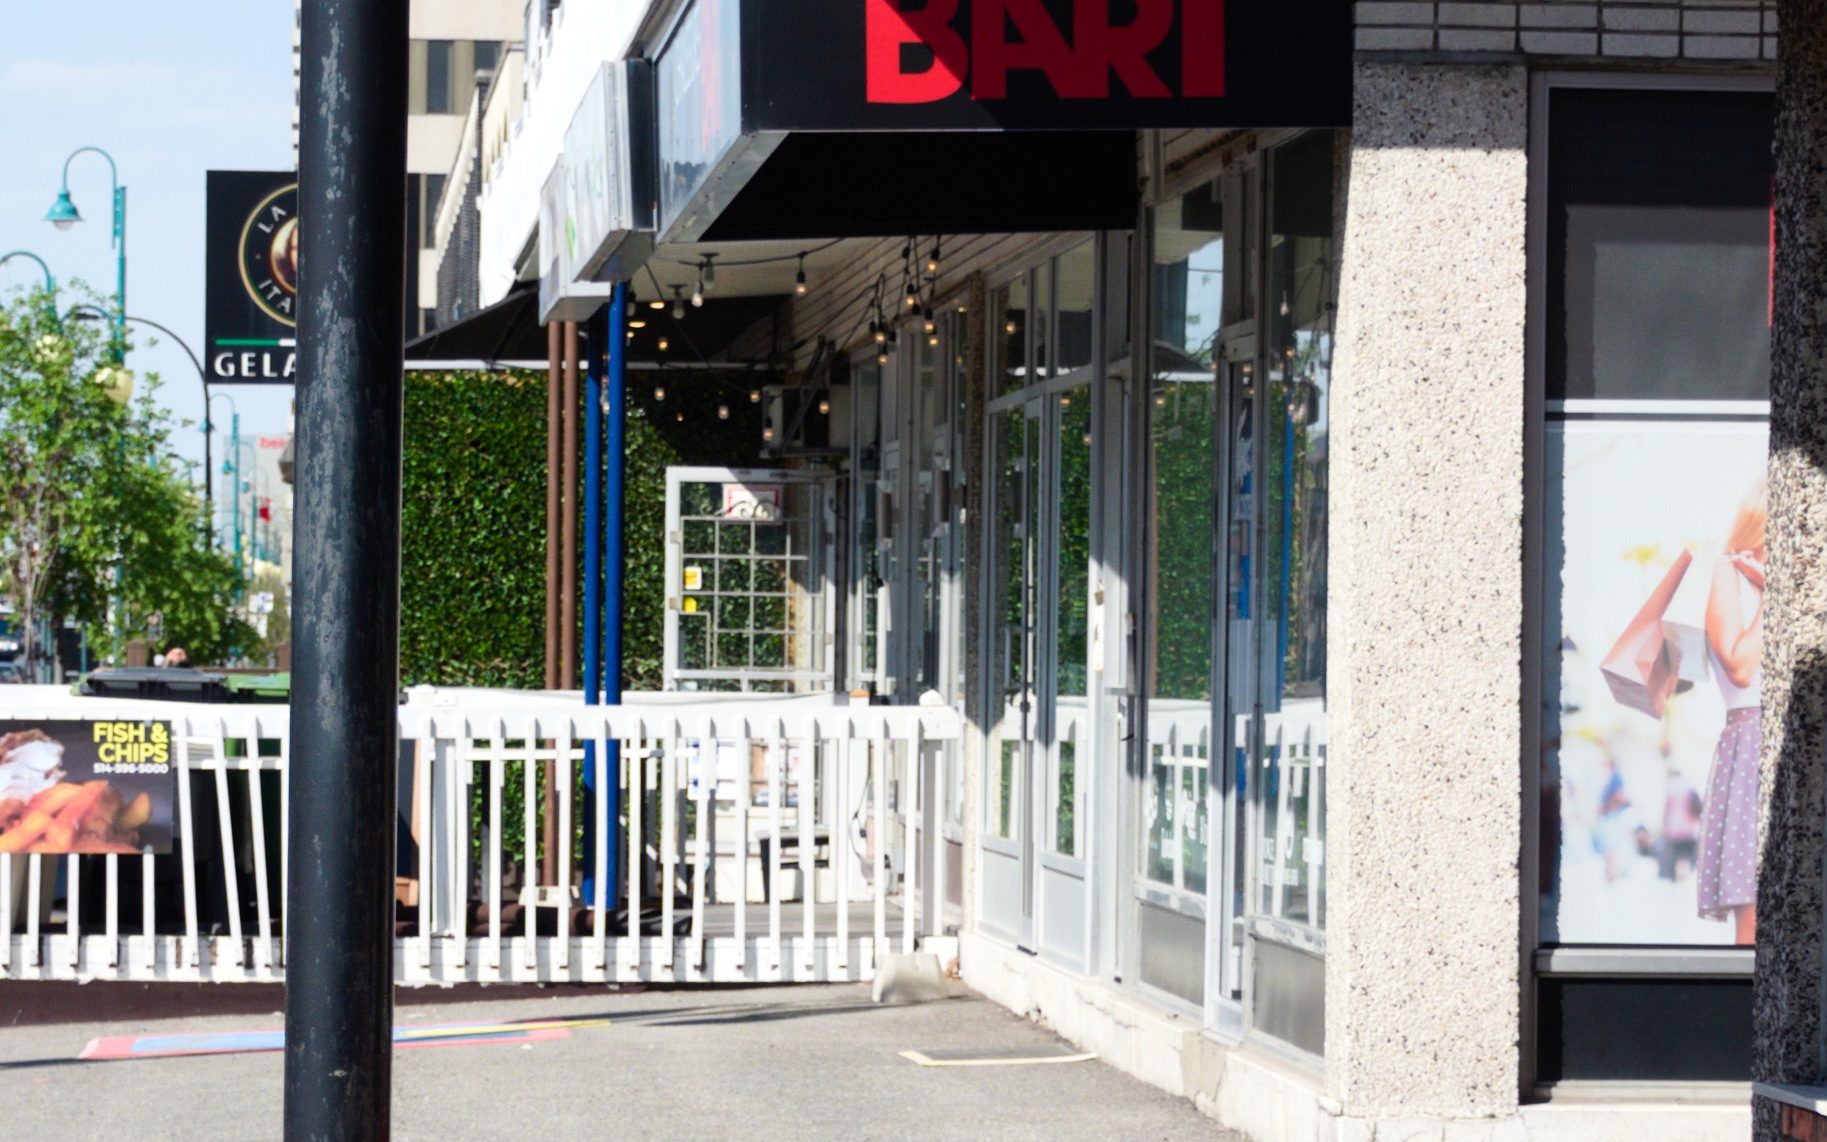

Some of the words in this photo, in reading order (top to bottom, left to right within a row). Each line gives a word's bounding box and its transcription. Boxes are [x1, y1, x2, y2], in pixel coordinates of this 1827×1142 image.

[865, 0, 1226, 104] BARI
[93, 721, 146, 744] FISH
[150, 721, 169, 744] &
[97, 742, 169, 764] CHIPS
